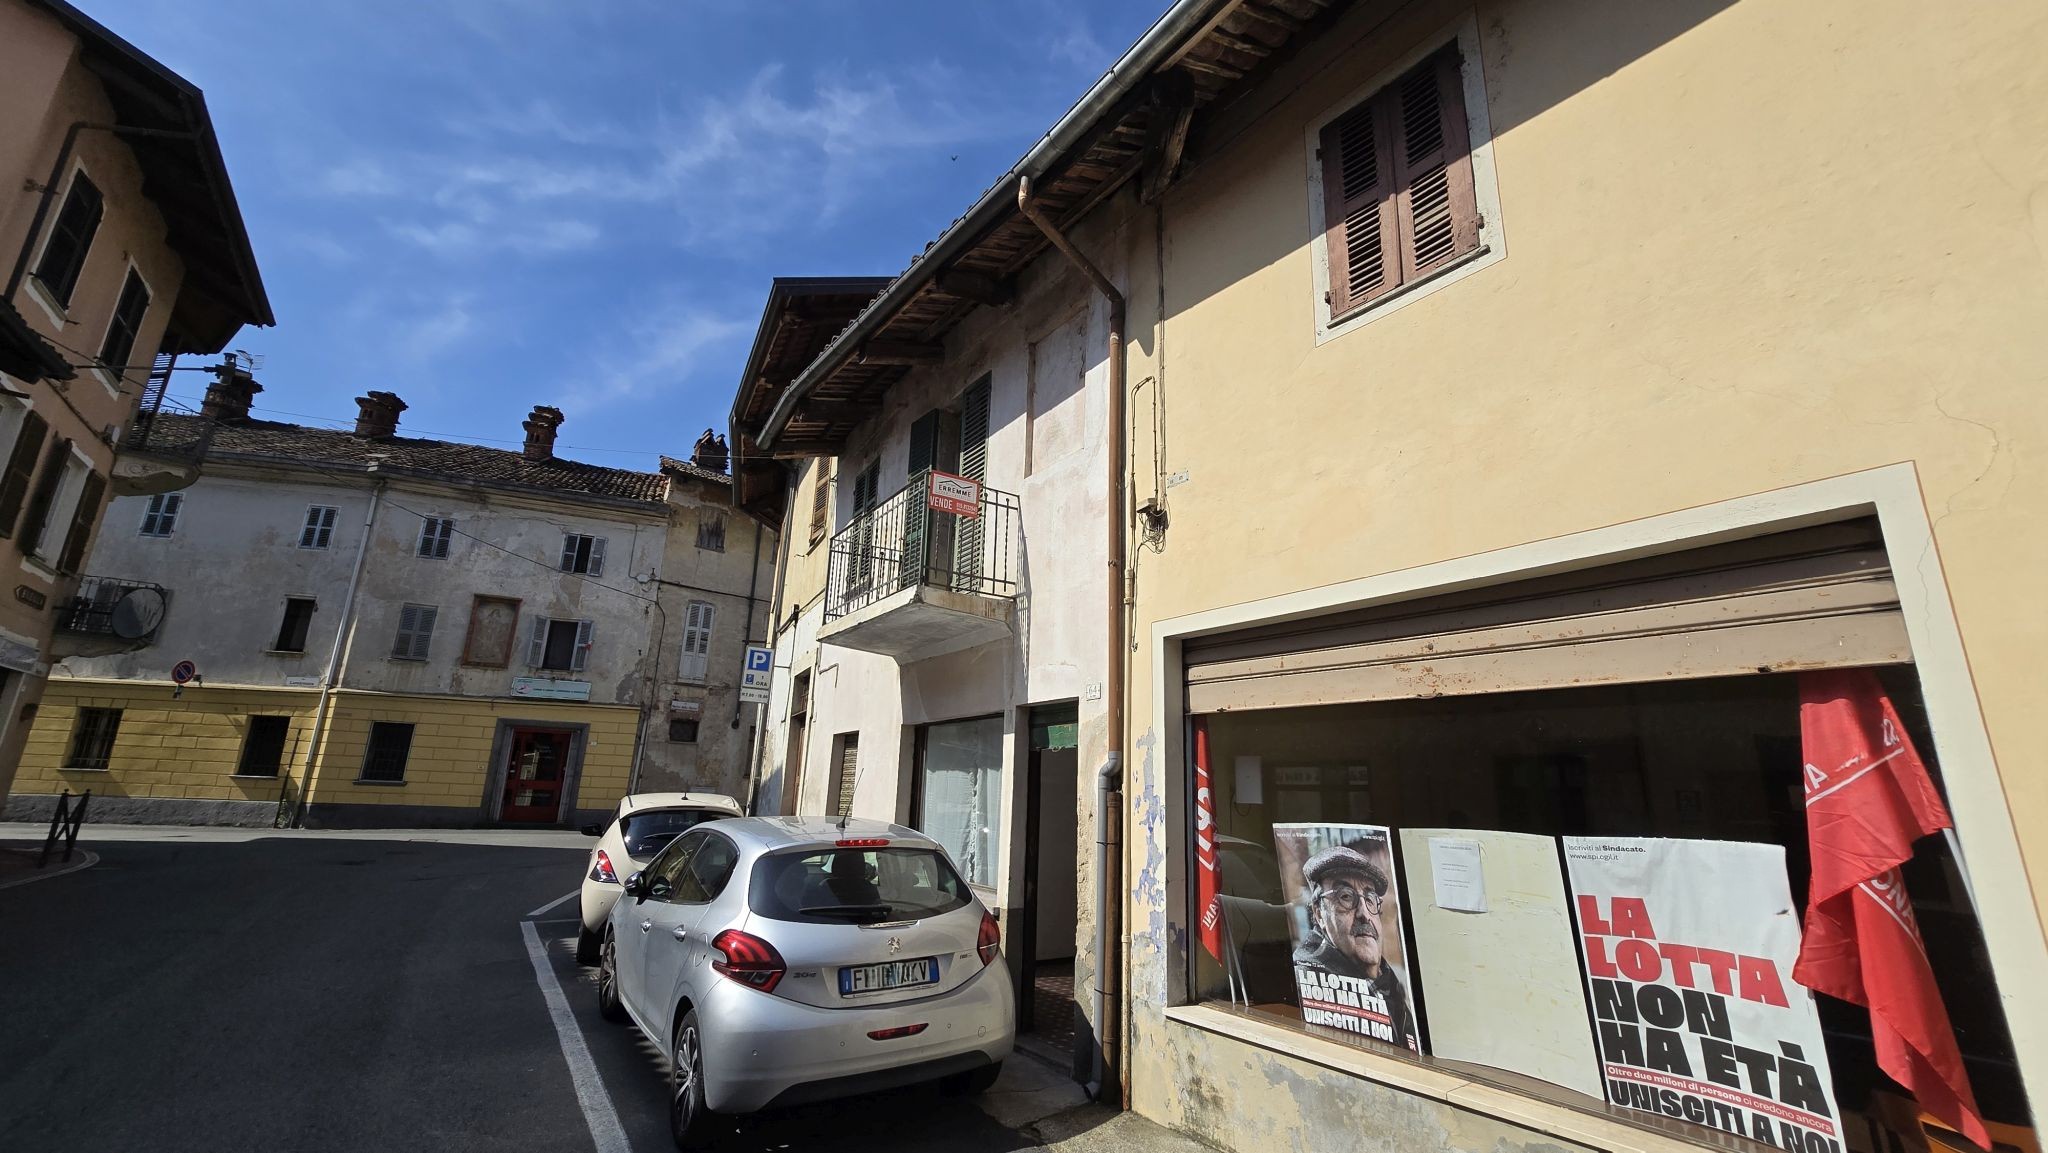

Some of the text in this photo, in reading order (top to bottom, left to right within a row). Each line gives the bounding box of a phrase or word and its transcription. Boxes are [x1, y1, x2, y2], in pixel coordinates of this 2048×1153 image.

[929, 495, 953, 510] VENDE
[938, 484, 972, 498] ERREMME
[752, 651, 767, 668] P
[1569, 853, 1619, 861] www.spi.cgil.it
[1602, 845, 1647, 853] Sindacato.
[1577, 895, 1656, 940] LA
[1298, 969, 1370, 995] LA LOTTA
[1584, 936, 1791, 1009] LOTTA
[1300, 983, 1336, 1003] NON
[1336, 989, 1361, 1008] HA
[1591, 978, 1733, 1042] NON
[1303, 1007, 1360, 1033] UNISCITI
[1361, 1018, 1371, 1036] A
[1371, 1021, 1394, 1043] NOI
[1599, 1020, 1833, 1119] HA ETÀ
[1608, 1066, 1833, 1133] Oltre due milioni di persone ci credono ancora
[1609, 1080, 1747, 1137] UNISCITI
[1752, 1112, 1778, 1149] A
